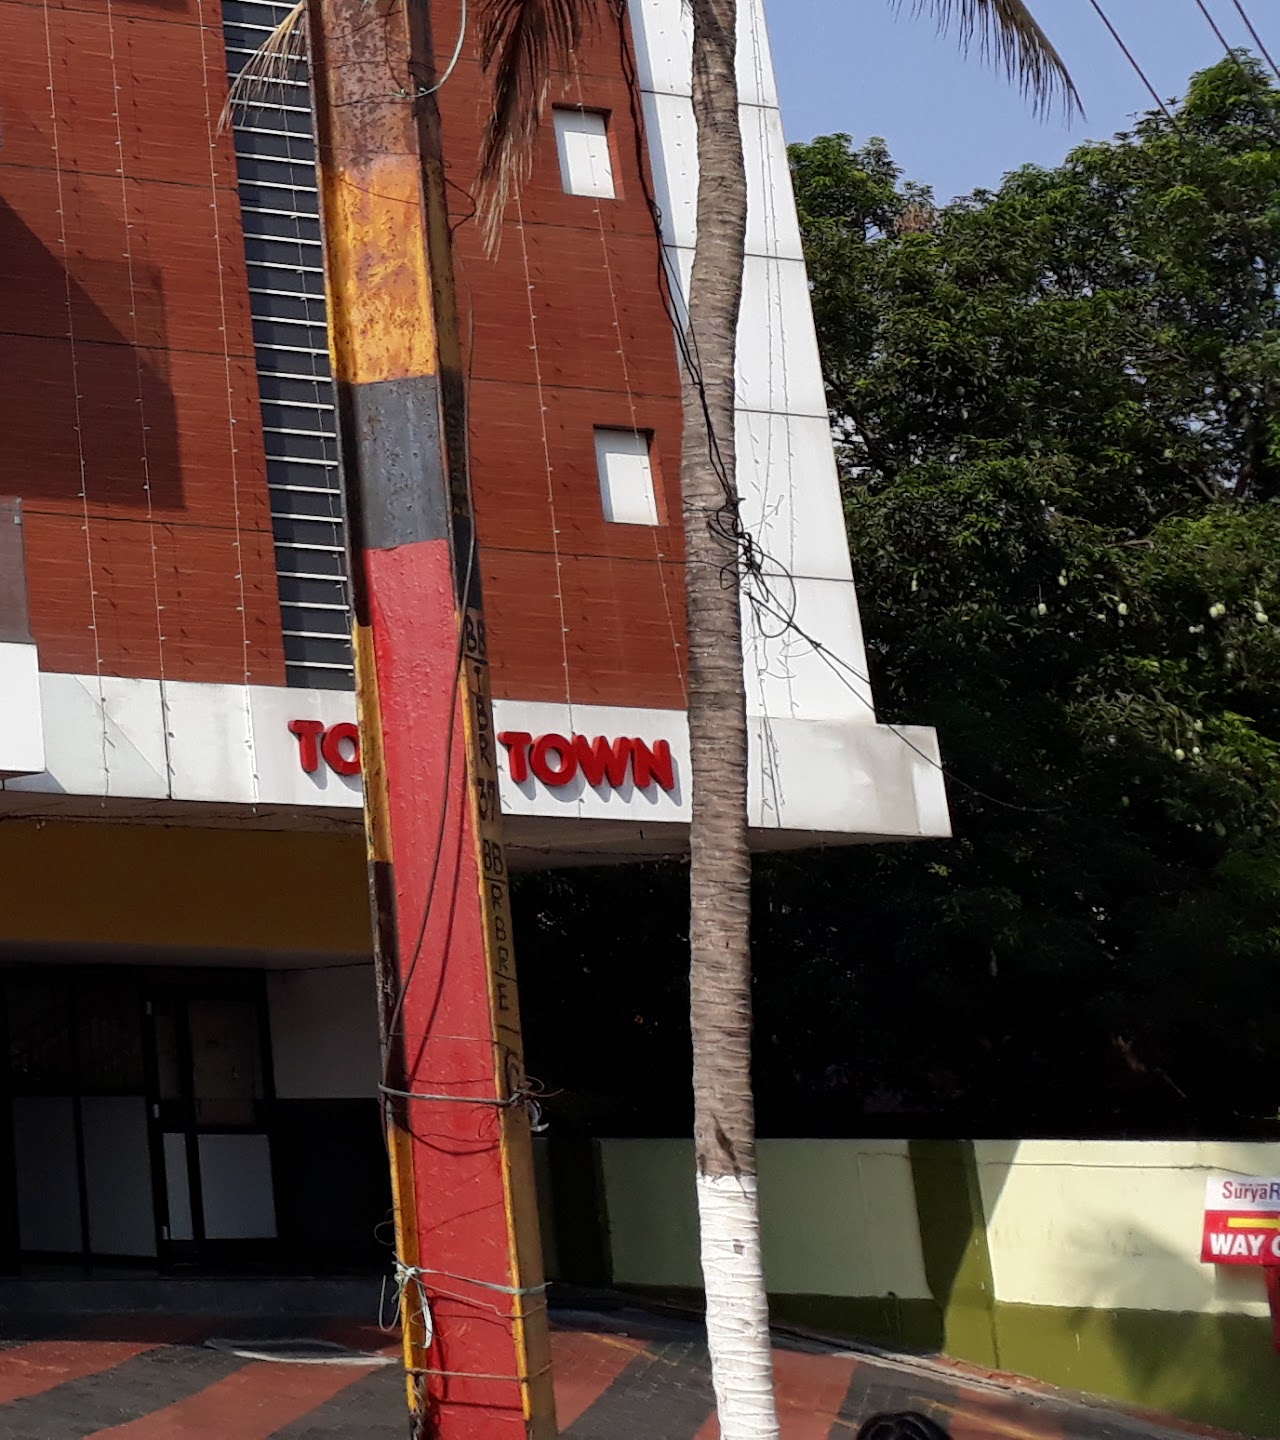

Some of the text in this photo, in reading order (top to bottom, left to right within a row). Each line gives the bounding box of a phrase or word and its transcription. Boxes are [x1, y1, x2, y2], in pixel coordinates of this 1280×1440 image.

[288, 720, 675, 791] TO TOWN
[1210, 1233, 1266, 1257] WAY
